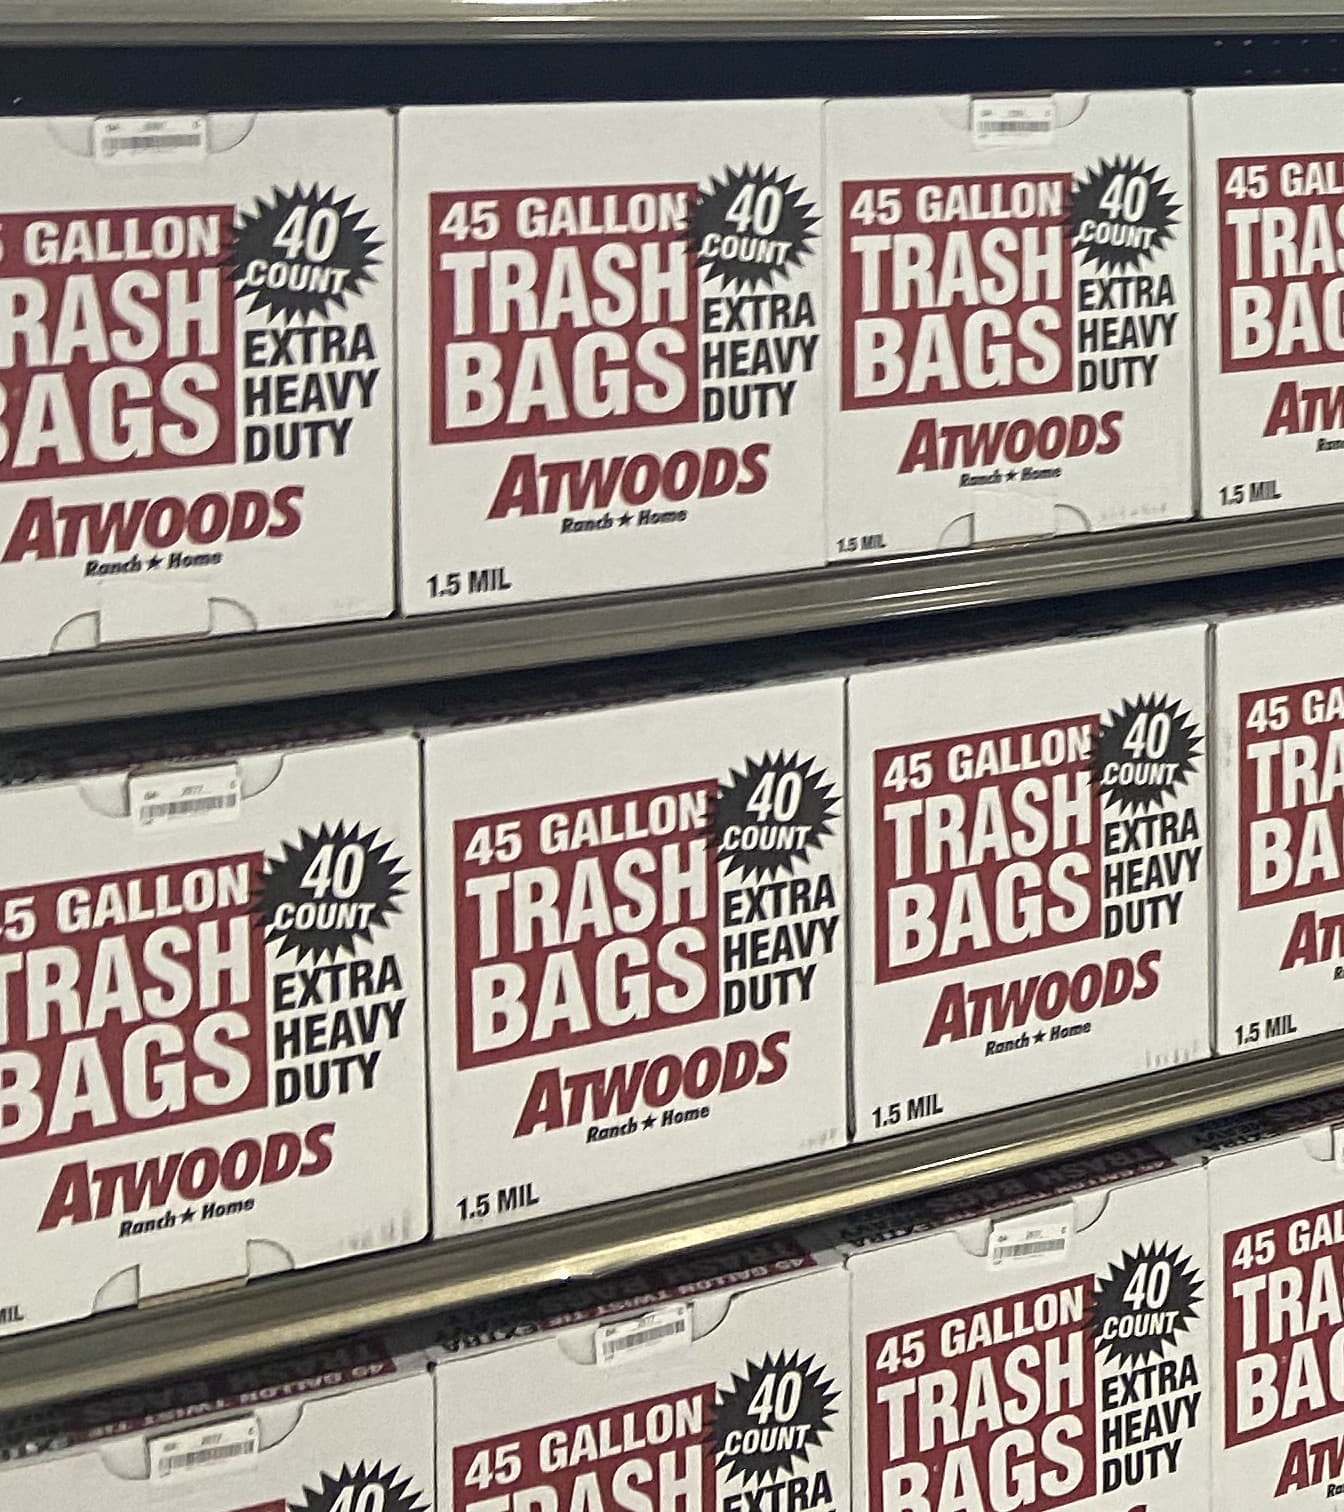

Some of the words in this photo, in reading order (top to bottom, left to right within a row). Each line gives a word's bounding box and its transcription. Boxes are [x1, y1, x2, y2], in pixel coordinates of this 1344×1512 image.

[850, 188, 901, 225] 45
[917, 181, 1063, 223] GALLON
[1099, 175, 1149, 221] 40
[1078, 219, 1157, 250] COUNT
[850, 226, 1062, 313] TRASH
[1079, 274, 1174, 312] EXTRA
[854, 306, 1062, 398] BAGS
[1079, 313, 1179, 353] HEAVY
[1079, 355, 1158, 392] DUTY
[897, 411, 1123, 474] ATWOODS
[958, 467, 1001, 487] Ranch
[1021, 467, 1063, 481] Home
[836, 537, 858, 553] 1.5
[861, 533, 887, 551] MIL
[1245, 693, 1287, 731] 45
[746, 768, 803, 825] 40
[463, 820, 520, 867] 45
[539, 787, 708, 853] GALLON
[720, 824, 812, 851] COUNT
[464, 837, 708, 960] TRASH
[725, 872, 835, 927] EXTRA
[725, 915, 840, 974] HEAVY
[471, 927, 708, 1054] BAGS
[725, 963, 818, 1017] DUTY
[1234, 1022, 1259, 1046] 1.5
[1265, 1014, 1297, 1039] MIL
[512, 1029, 791, 1138] ATWOODS
[585, 1115, 636, 1144] Ranch
[661, 1104, 709, 1127] Home
[456, 1193, 489, 1221] 1.5
[496, 1183, 539, 1212] MIL
[1231, 1228, 1275, 1270] 45
